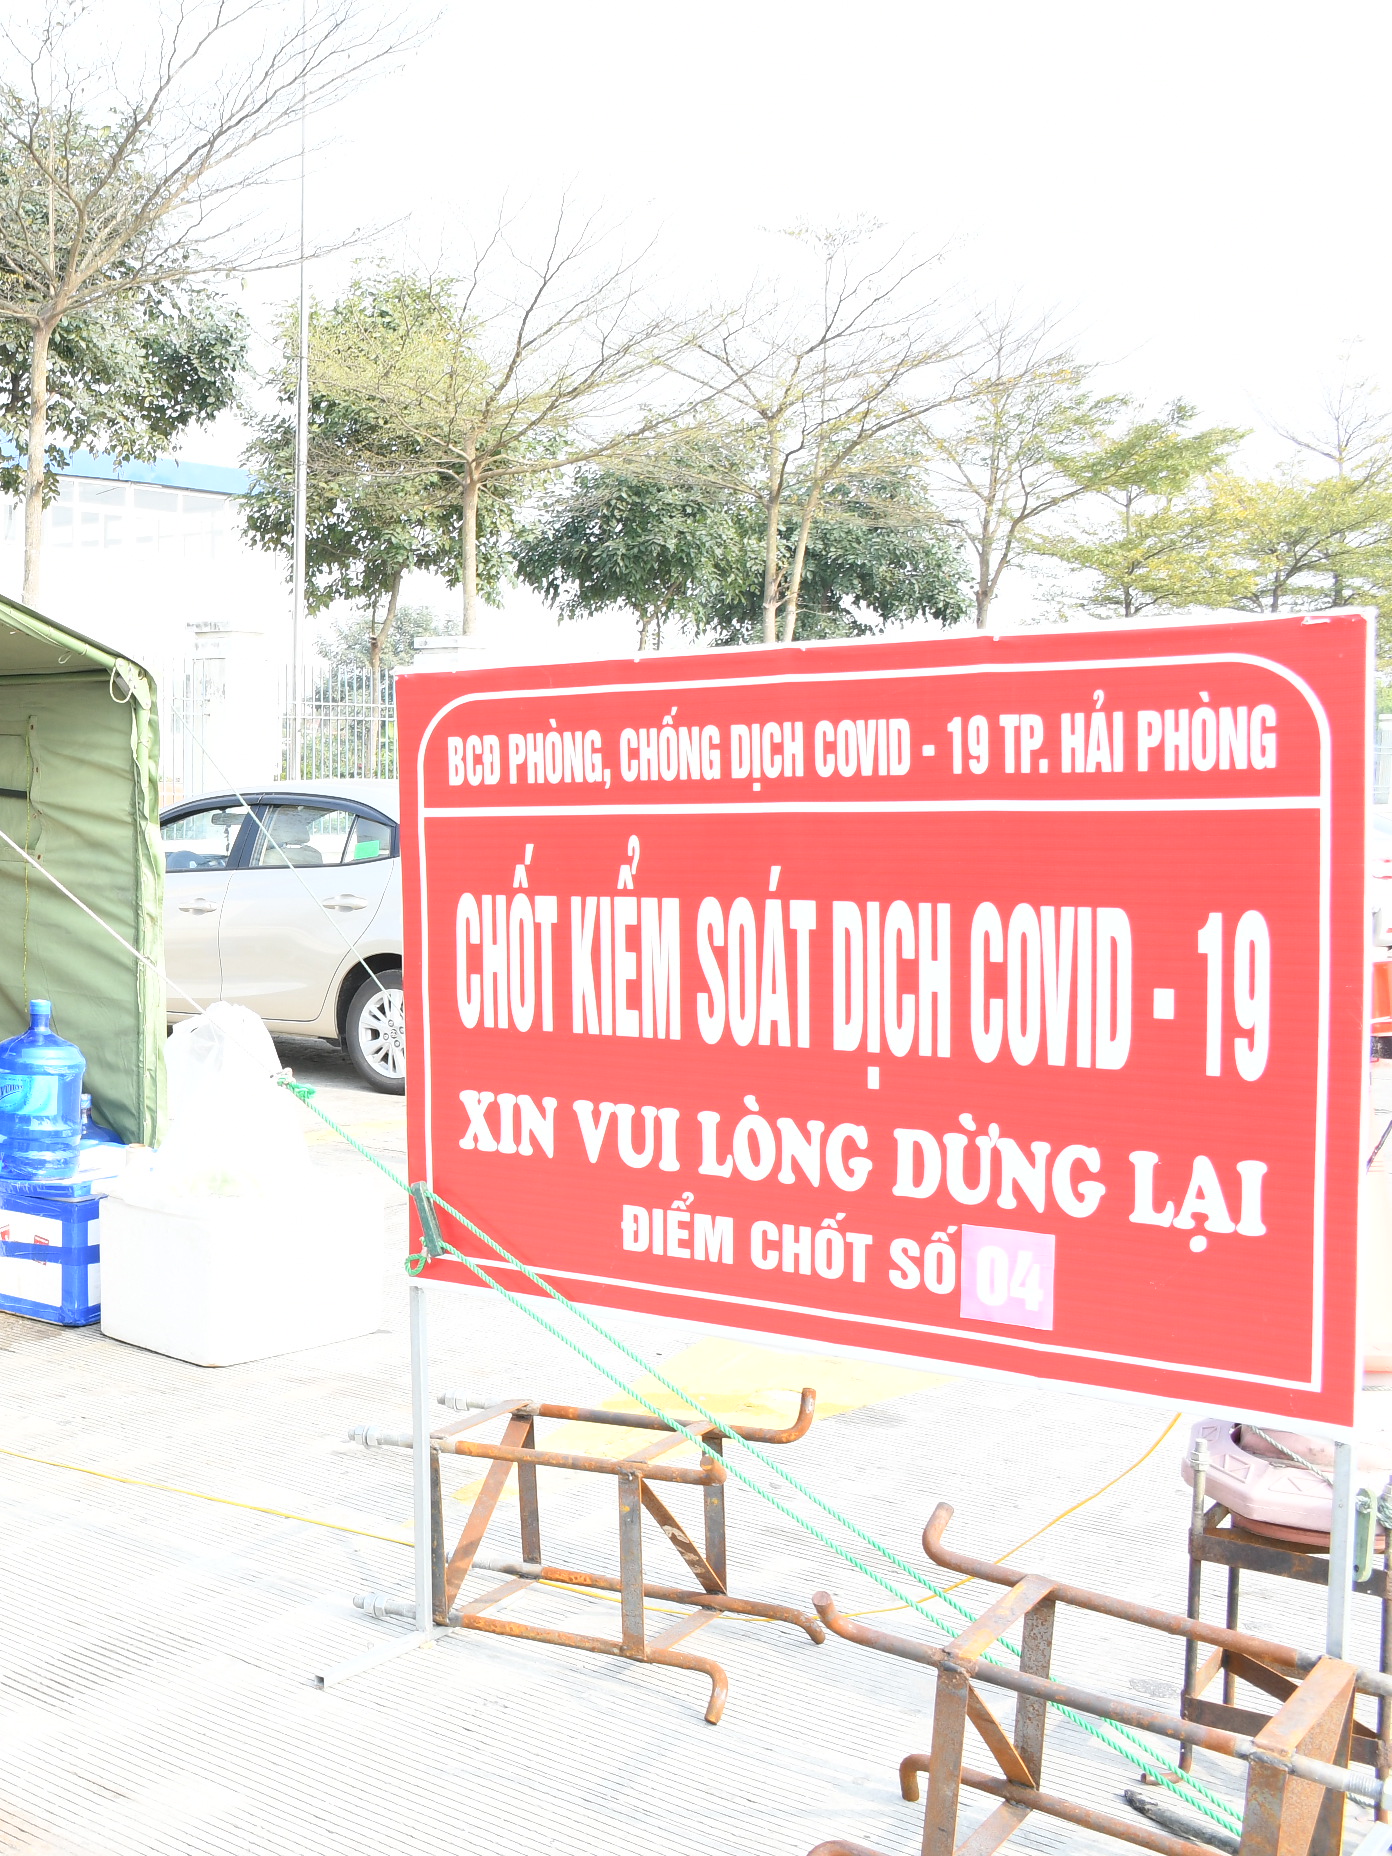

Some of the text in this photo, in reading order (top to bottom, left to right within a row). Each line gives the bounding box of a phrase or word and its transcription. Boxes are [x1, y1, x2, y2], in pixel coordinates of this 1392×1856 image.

[448, 690, 1277, 792] BCĐ PHÒNG, CHỐNG DỊCH COVID - 19 TP. HẢI PHÒNG
[456, 835, 1271, 1090] CHỐT KIỂM SOÁT DỊCH COVID - 19
[459, 1090, 1268, 1253] XIN VUI LÒNG DỪNG LẠI
[621, 1191, 1044, 1312] ĐIỂM CHỐT SỐ 04
